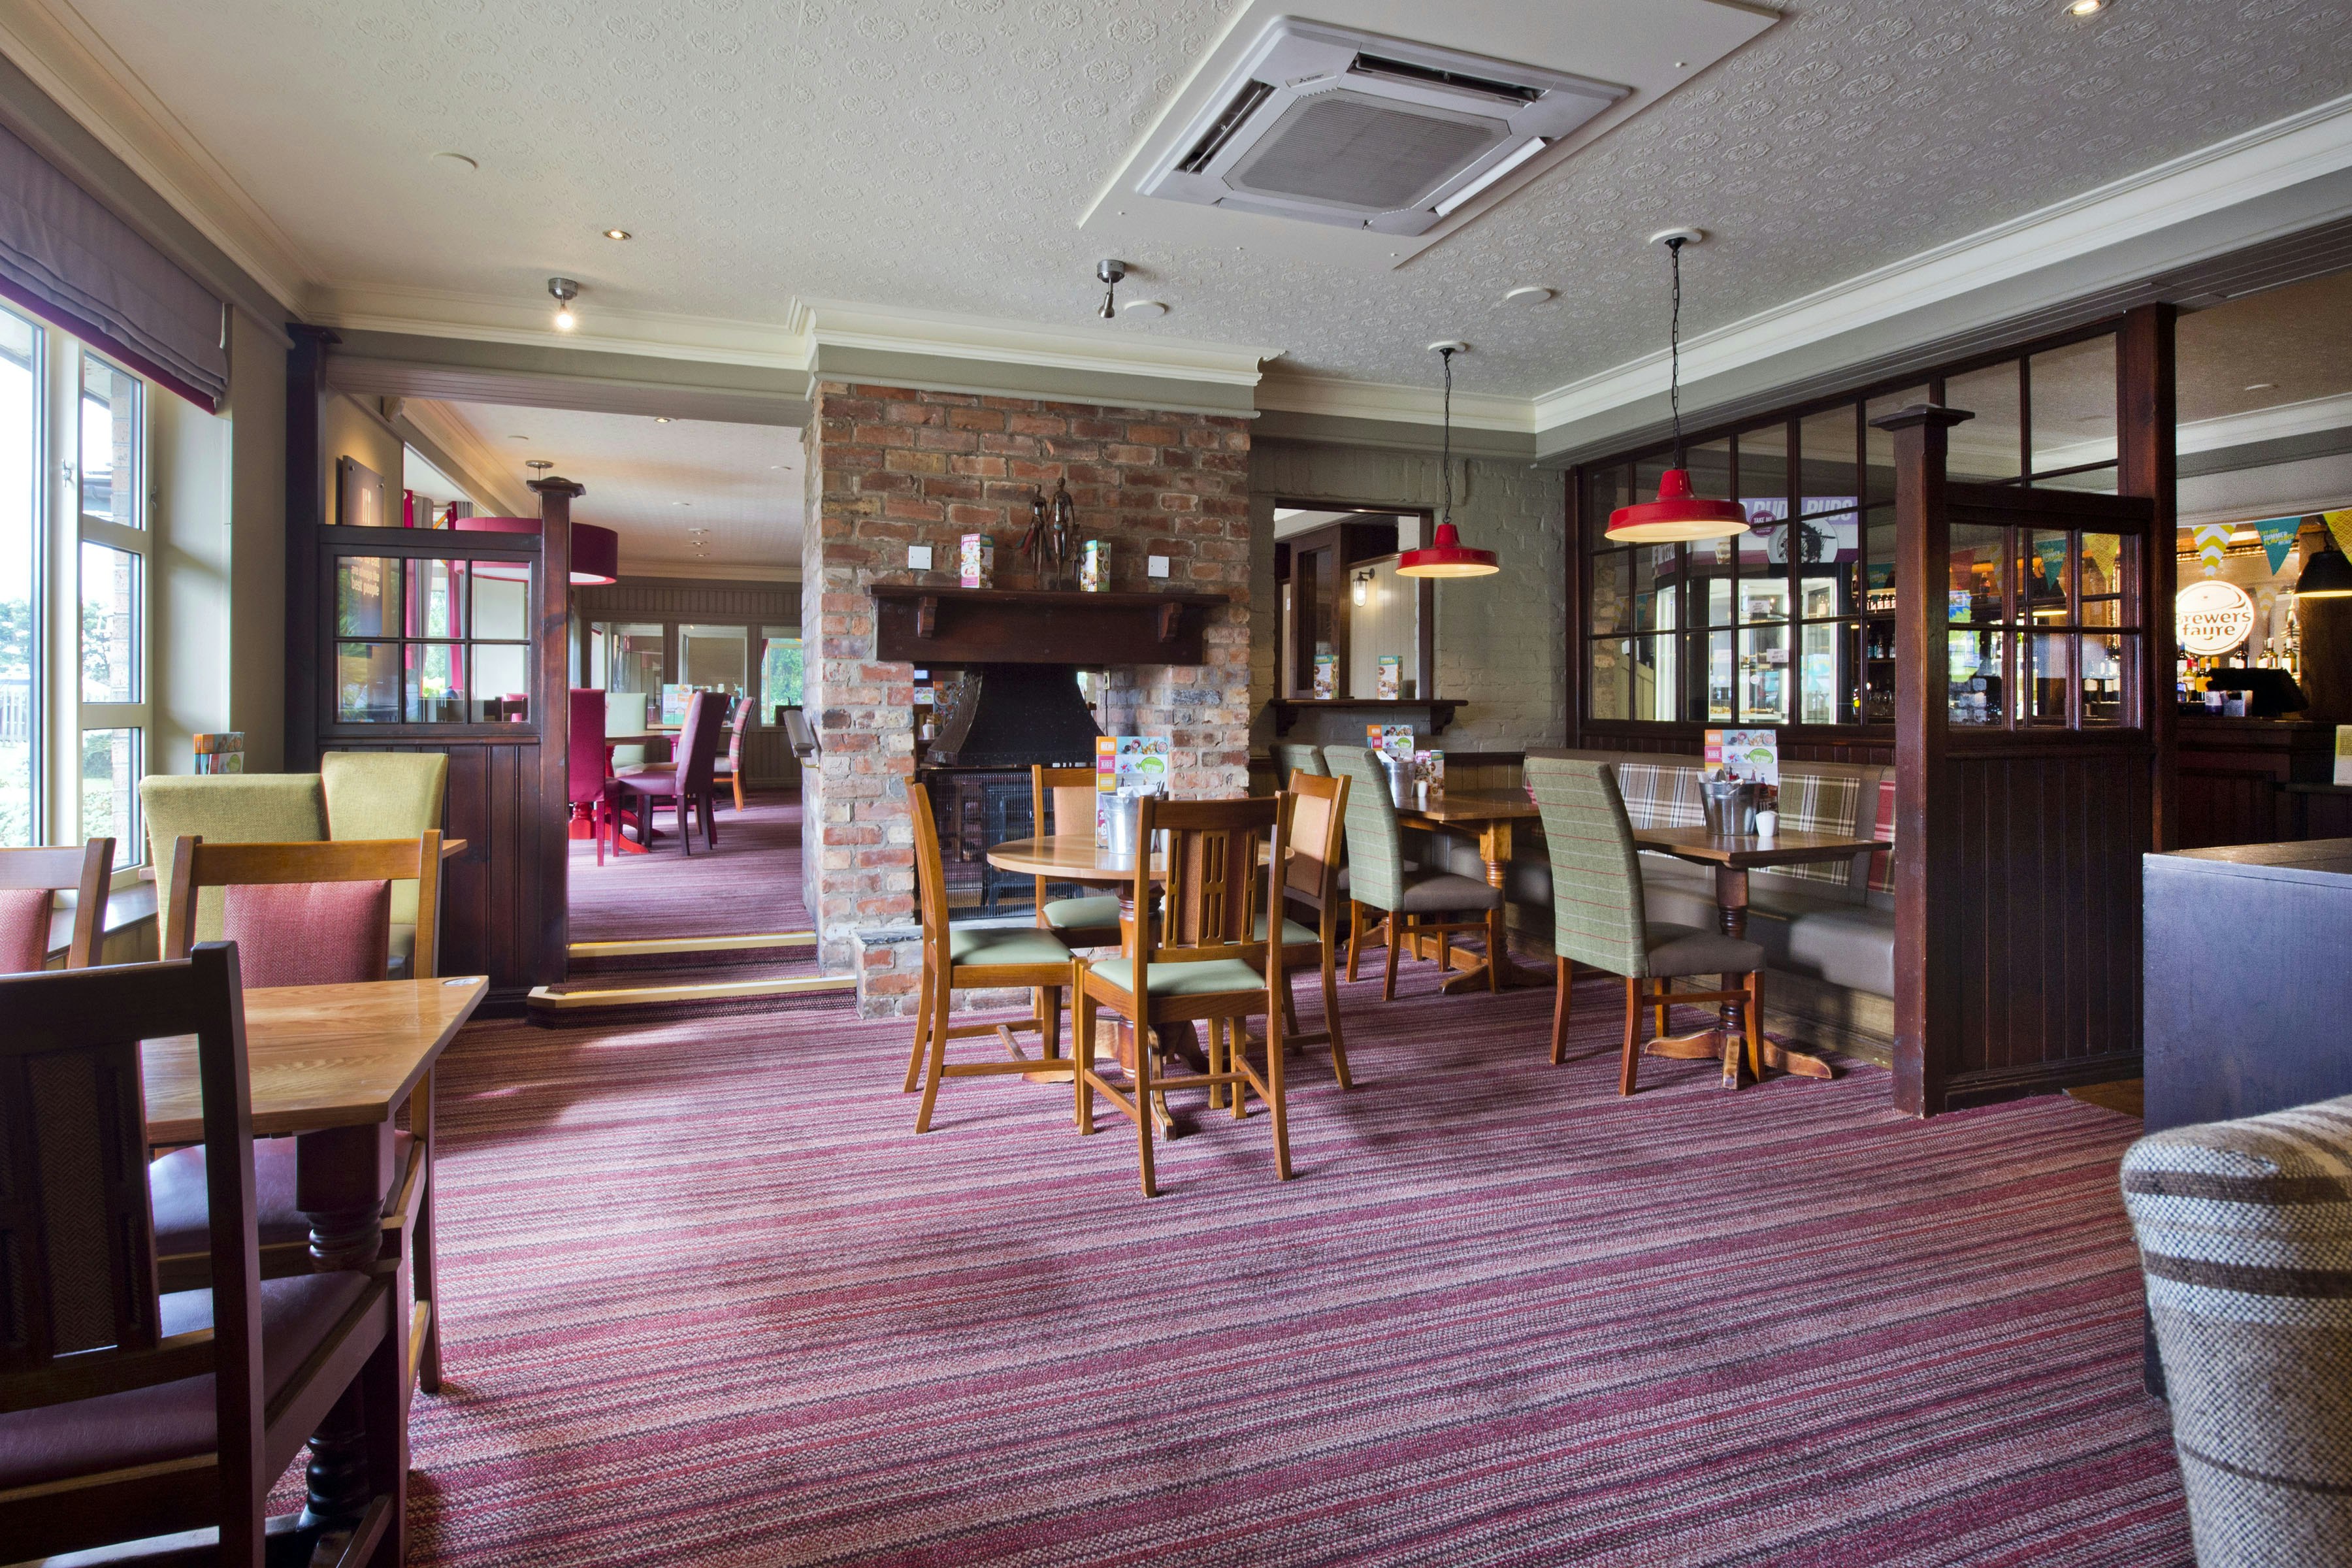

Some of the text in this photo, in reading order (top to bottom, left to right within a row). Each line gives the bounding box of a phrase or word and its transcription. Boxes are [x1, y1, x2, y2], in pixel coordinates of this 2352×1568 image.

[351, 575, 380, 597] best people
[2179, 612, 2251, 625] rewers
[2183, 624, 2236, 641] fayre
